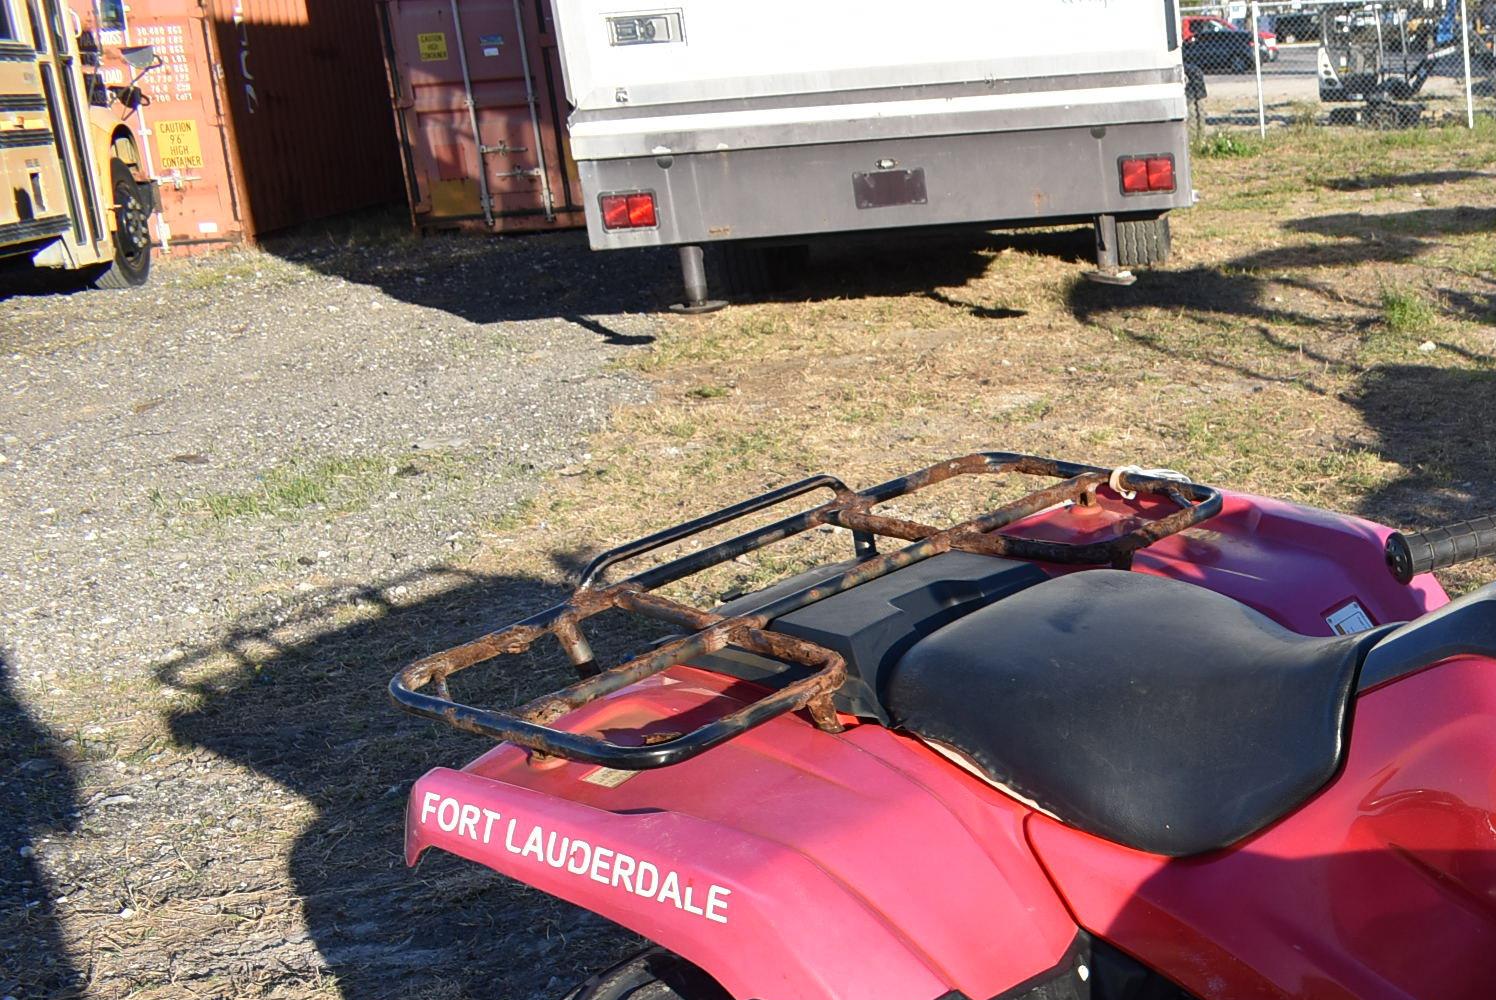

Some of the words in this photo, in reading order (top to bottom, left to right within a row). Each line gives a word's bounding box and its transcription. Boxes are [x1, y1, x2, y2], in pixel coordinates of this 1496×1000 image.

[159, 122, 192, 133] CAUTION
[170, 145, 189, 156] HIGH
[162, 156, 202, 168] CONTAINER
[421, 791, 501, 844] FORT
[504, 818, 733, 924] LAUDERDALE
